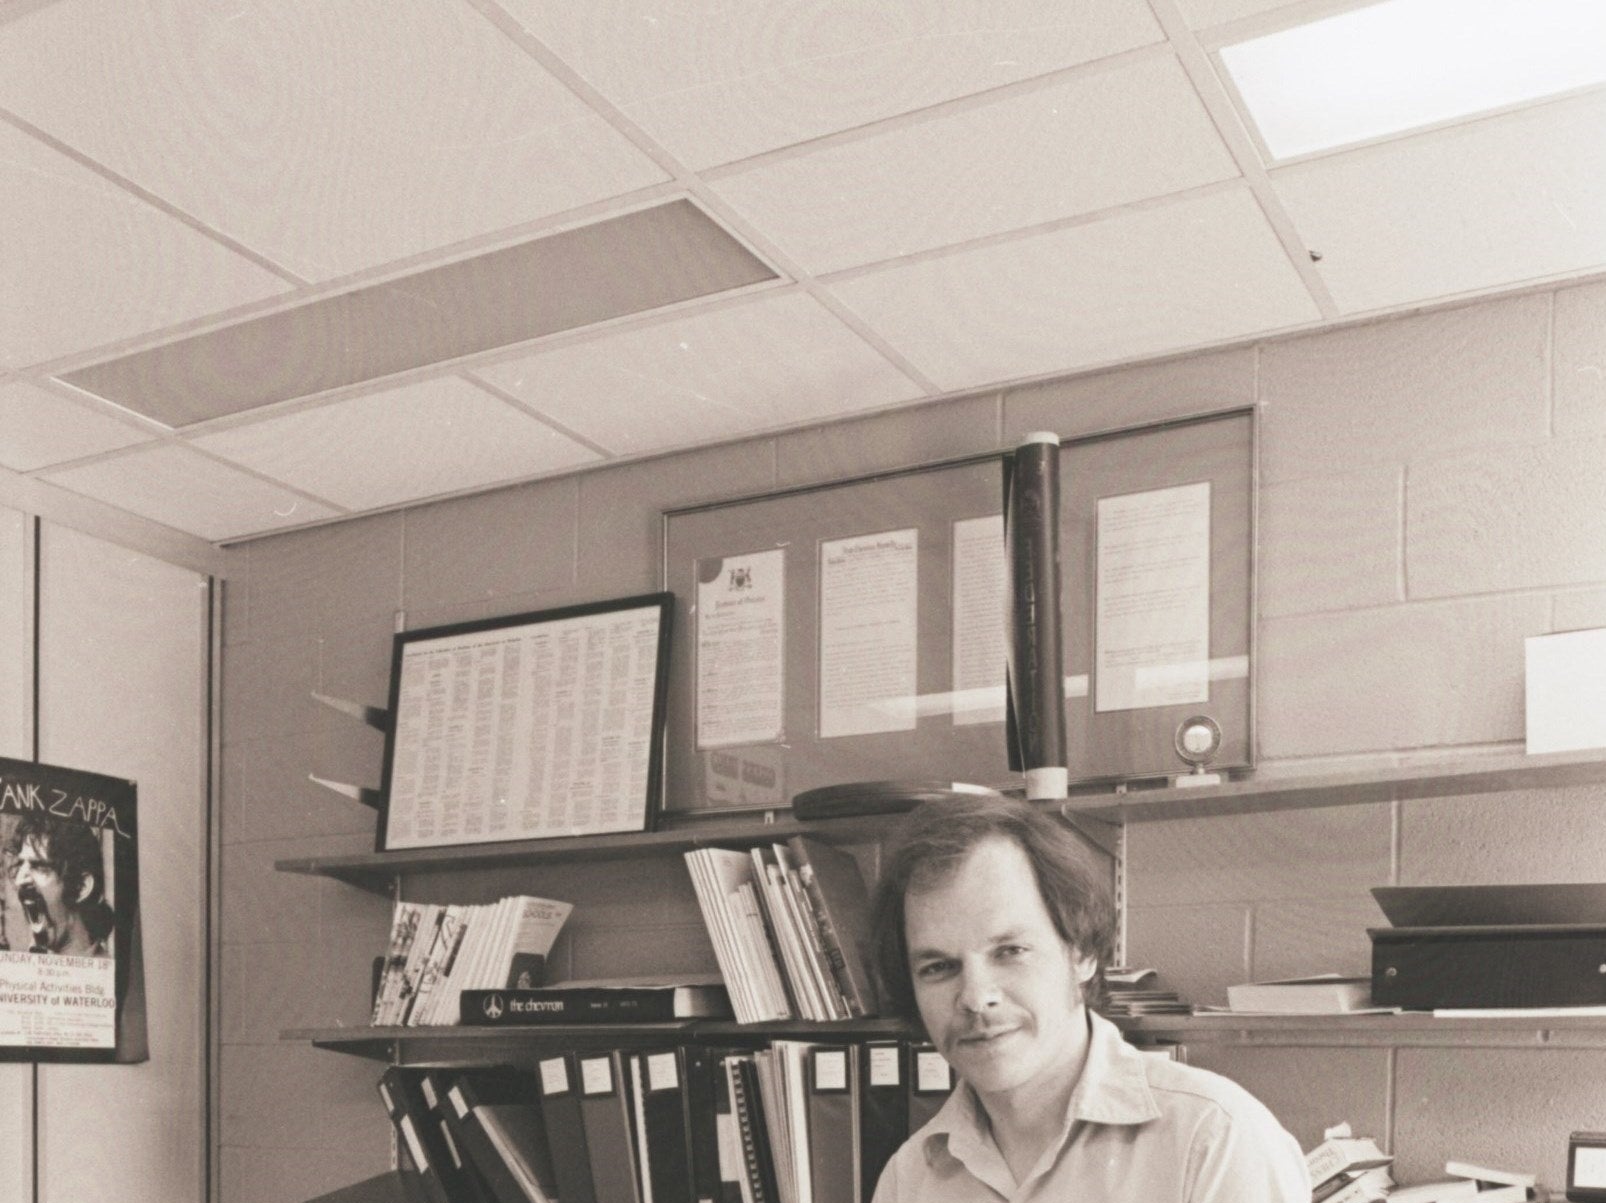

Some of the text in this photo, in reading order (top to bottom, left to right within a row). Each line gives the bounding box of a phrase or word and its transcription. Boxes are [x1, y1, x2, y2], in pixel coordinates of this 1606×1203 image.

[0, 783, 131, 839] ANK ZAPPA
[38, 955, 94, 968] NOVEMBER
[0, 979, 37, 991] Physical
[40, 981, 82, 994] Activities
[51, 996, 60, 1006] of
[63, 997, 115, 1008] WATERLOO
[510, 998, 564, 1012] the chevron
